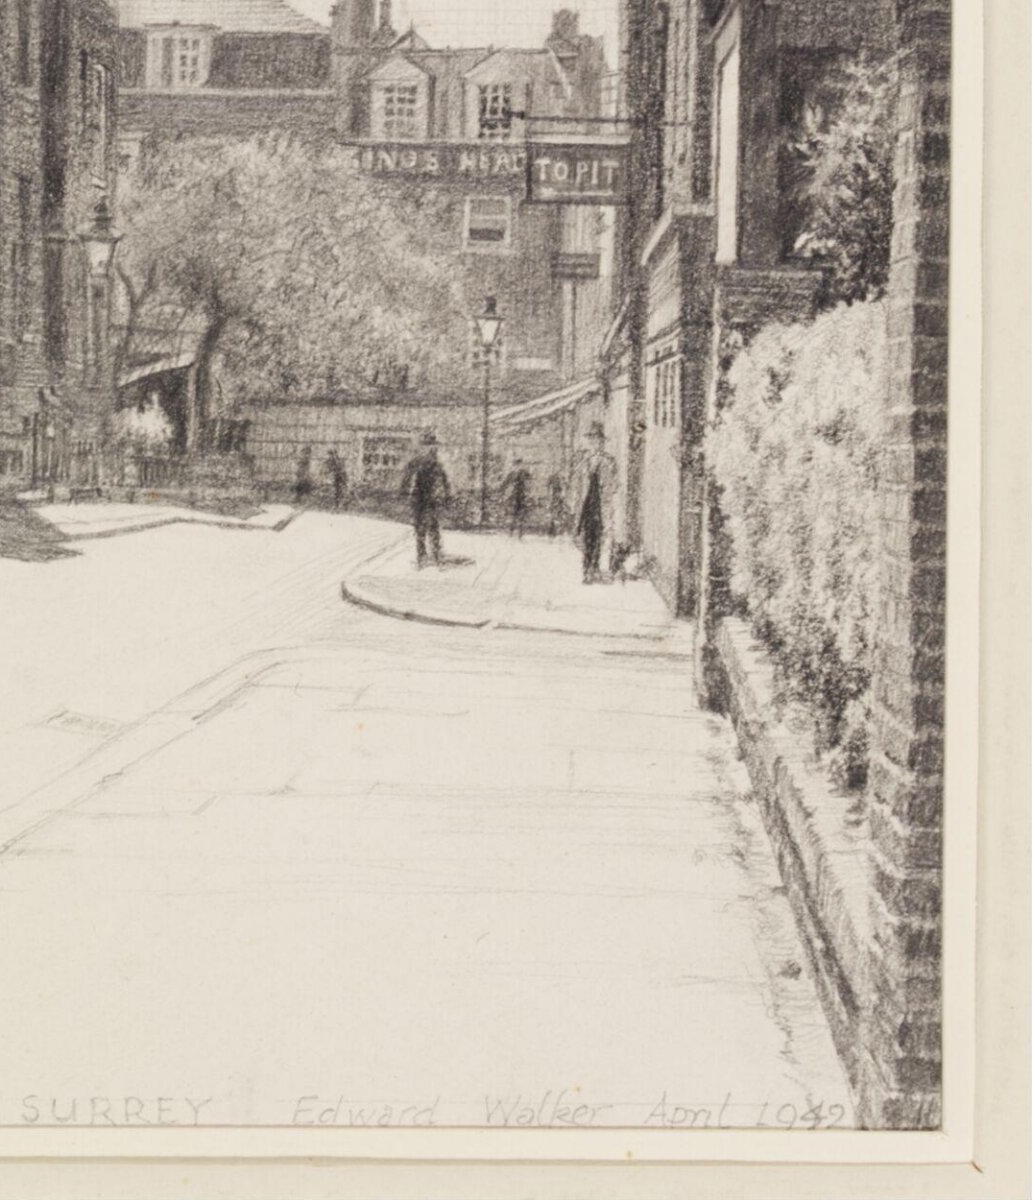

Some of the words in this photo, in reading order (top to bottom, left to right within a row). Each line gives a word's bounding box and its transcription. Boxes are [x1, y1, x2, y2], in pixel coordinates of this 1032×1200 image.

[21, 1094, 213, 1125] SURREY
[291, 1094, 440, 1126] Edward
[484, 1089, 616, 1127] Walker
[643, 1090, 732, 1127] April
